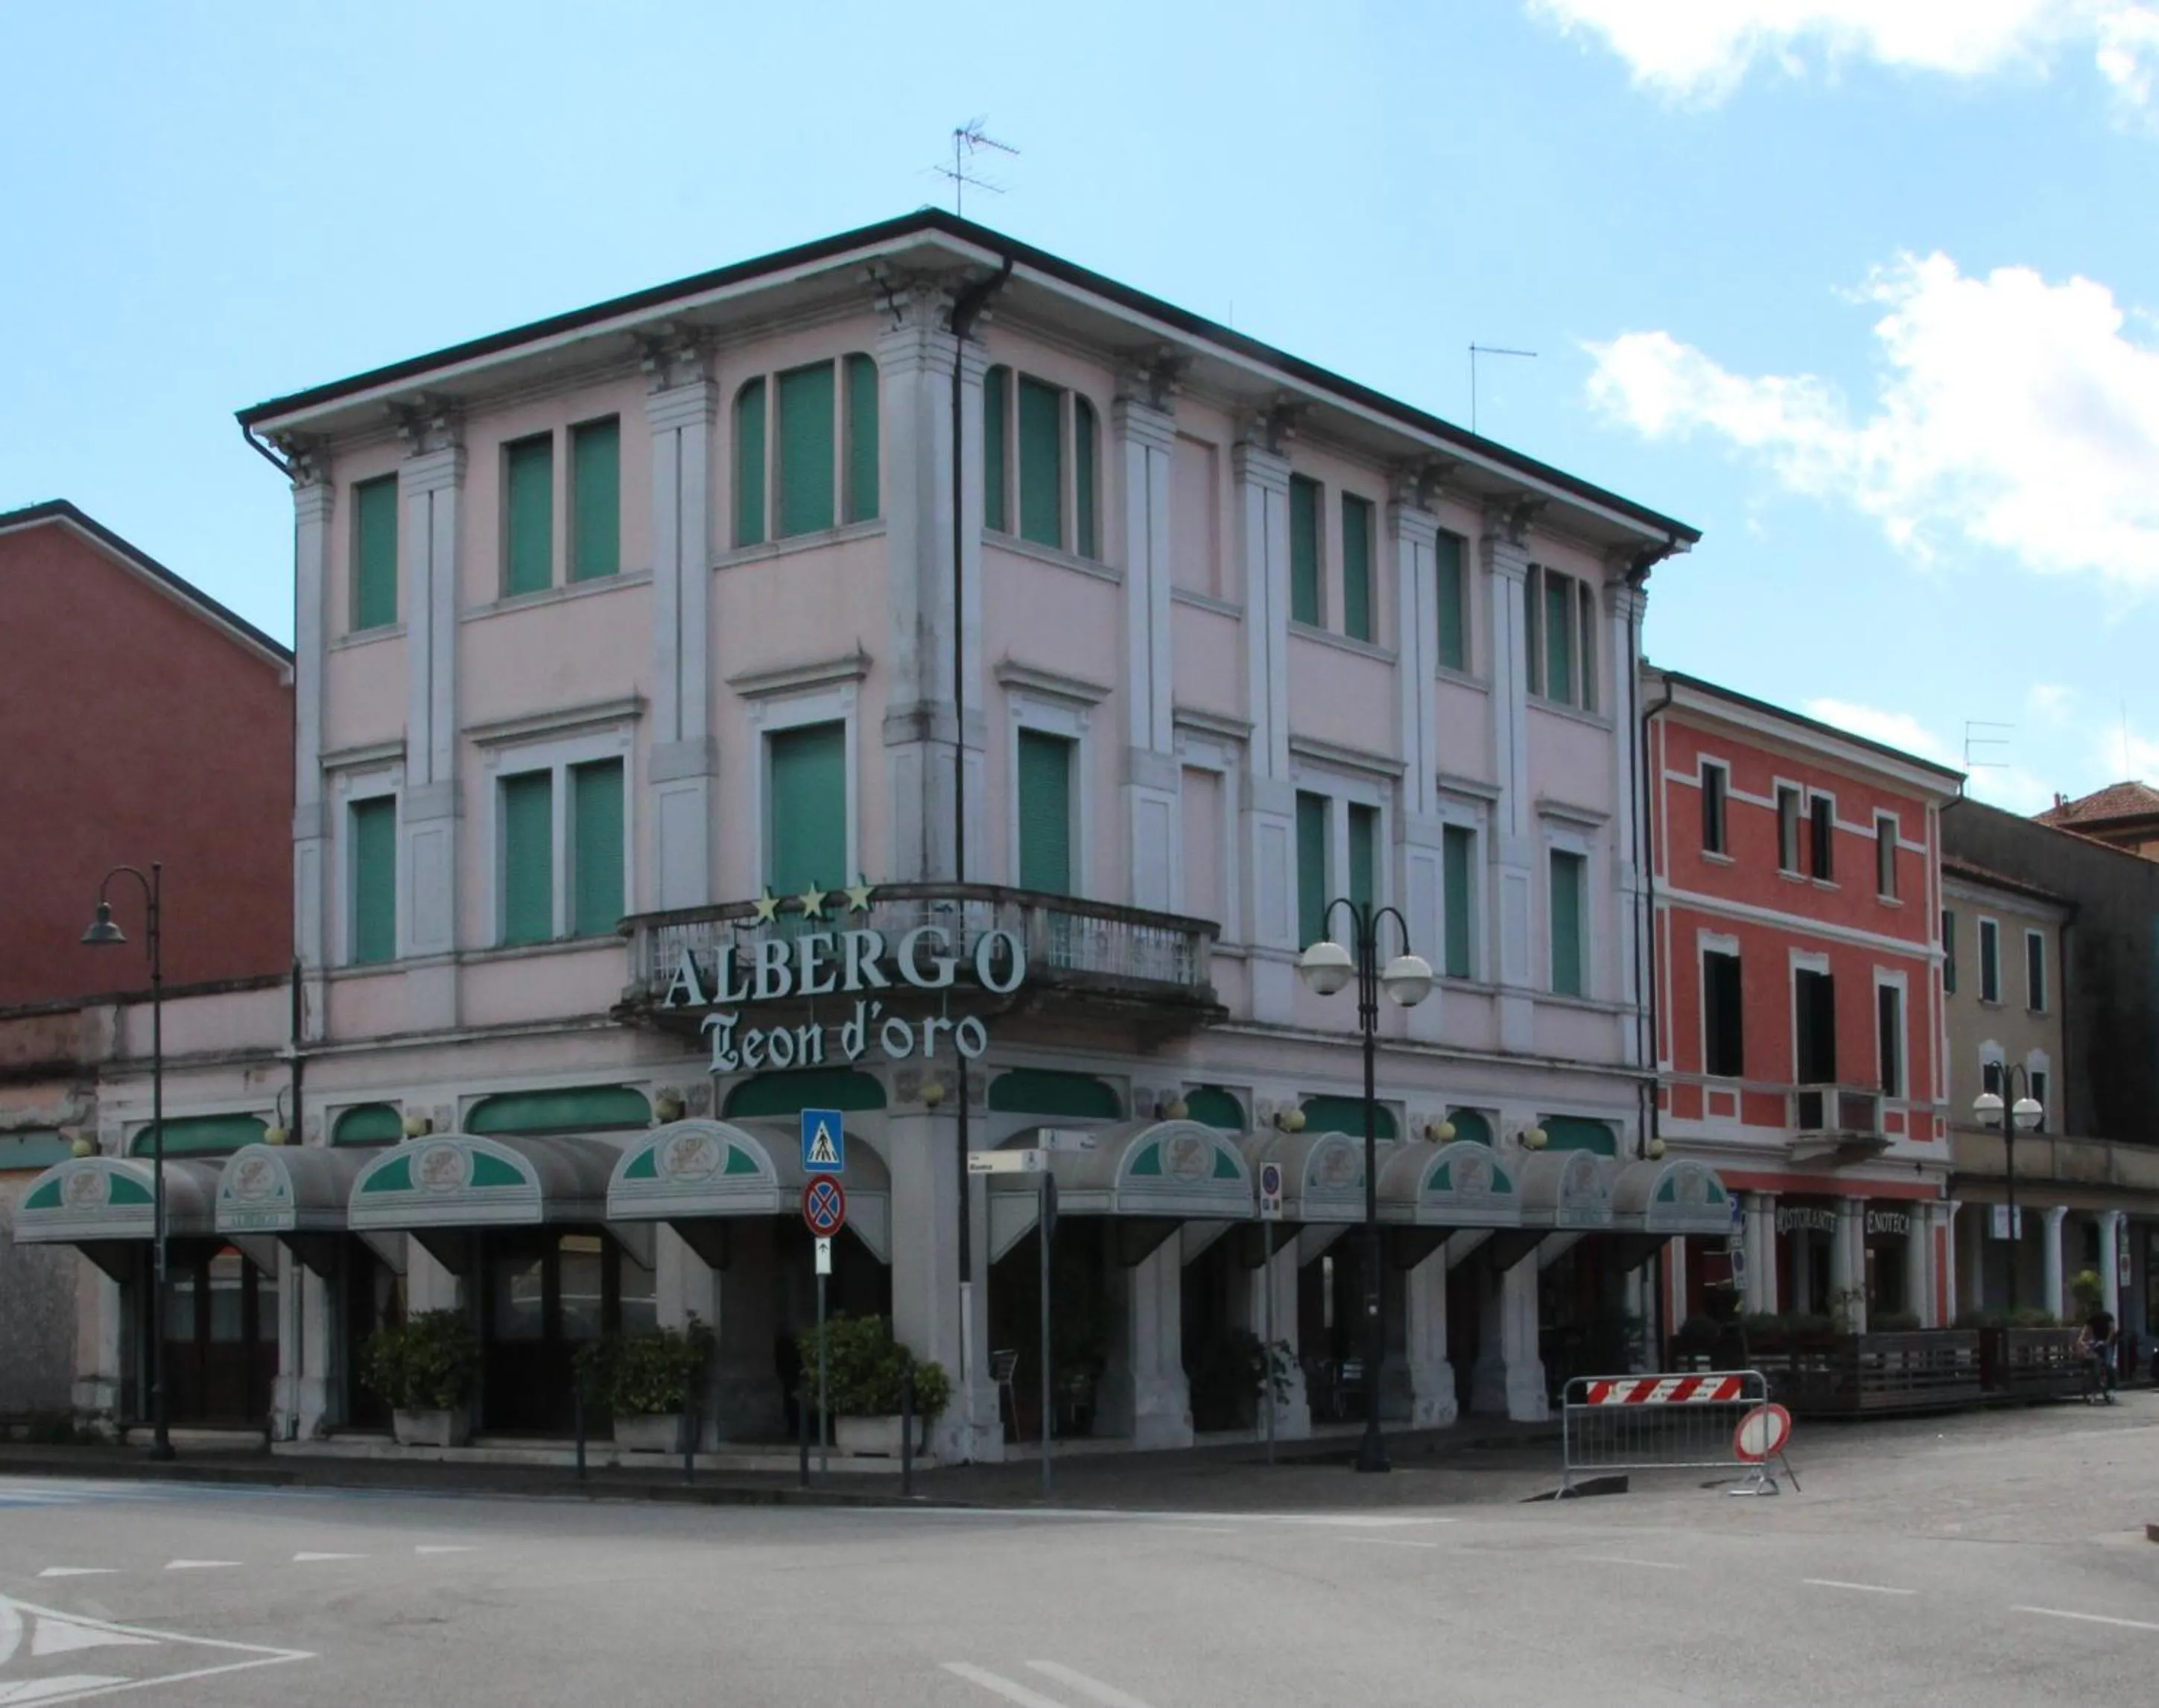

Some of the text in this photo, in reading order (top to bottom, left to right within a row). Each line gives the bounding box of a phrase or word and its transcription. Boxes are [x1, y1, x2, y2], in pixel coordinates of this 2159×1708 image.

[662, 925, 1026, 1009] ALBERGO
[700, 1000, 987, 1073] Leon d'oro
